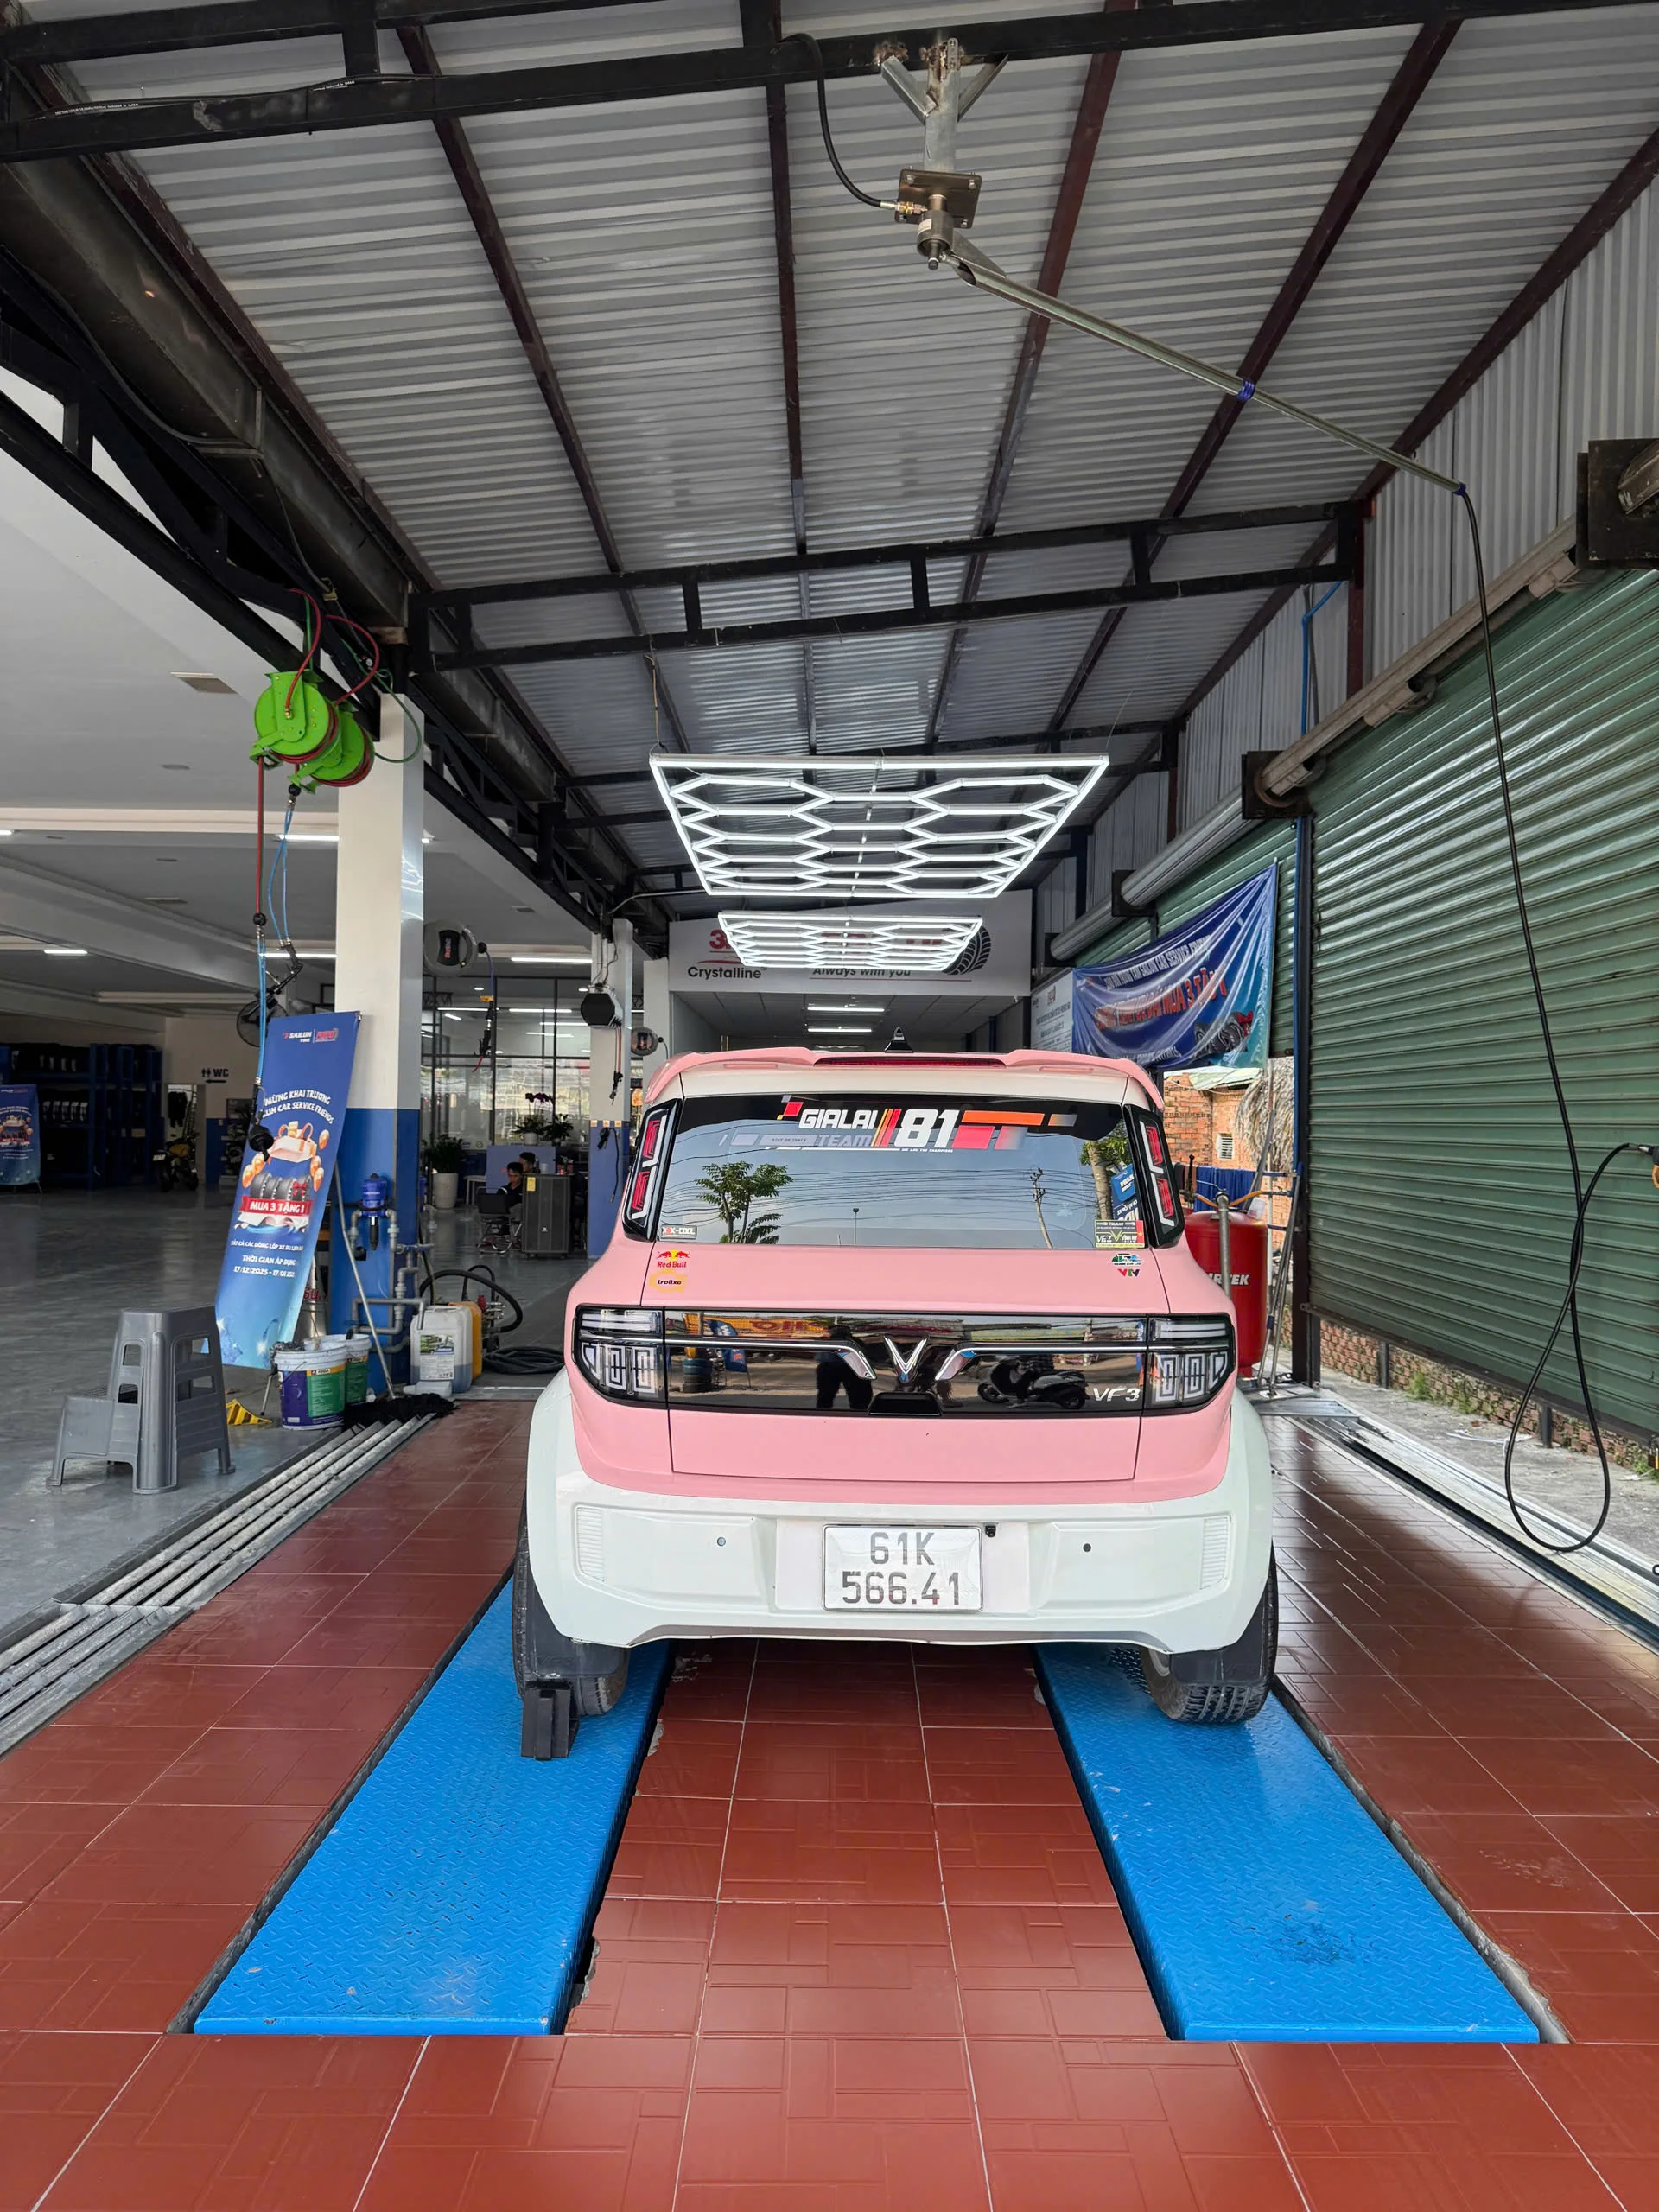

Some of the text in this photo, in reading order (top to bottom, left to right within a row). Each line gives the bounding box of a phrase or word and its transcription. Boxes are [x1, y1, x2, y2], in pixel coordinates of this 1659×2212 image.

[709, 929, 732, 950] 3
[213, 1068, 229, 1077] WC
[893, 1109, 960, 1148] 81
[818, 1135, 873, 1147] TEAM
[250, 1201, 269, 1211] MUA
[270, 1202, 276, 1211] 3
[1117, 1268, 1140, 1277] VTV
[870, 1531, 935, 1566] 61K
[842, 1571, 960, 1605] 566.41
